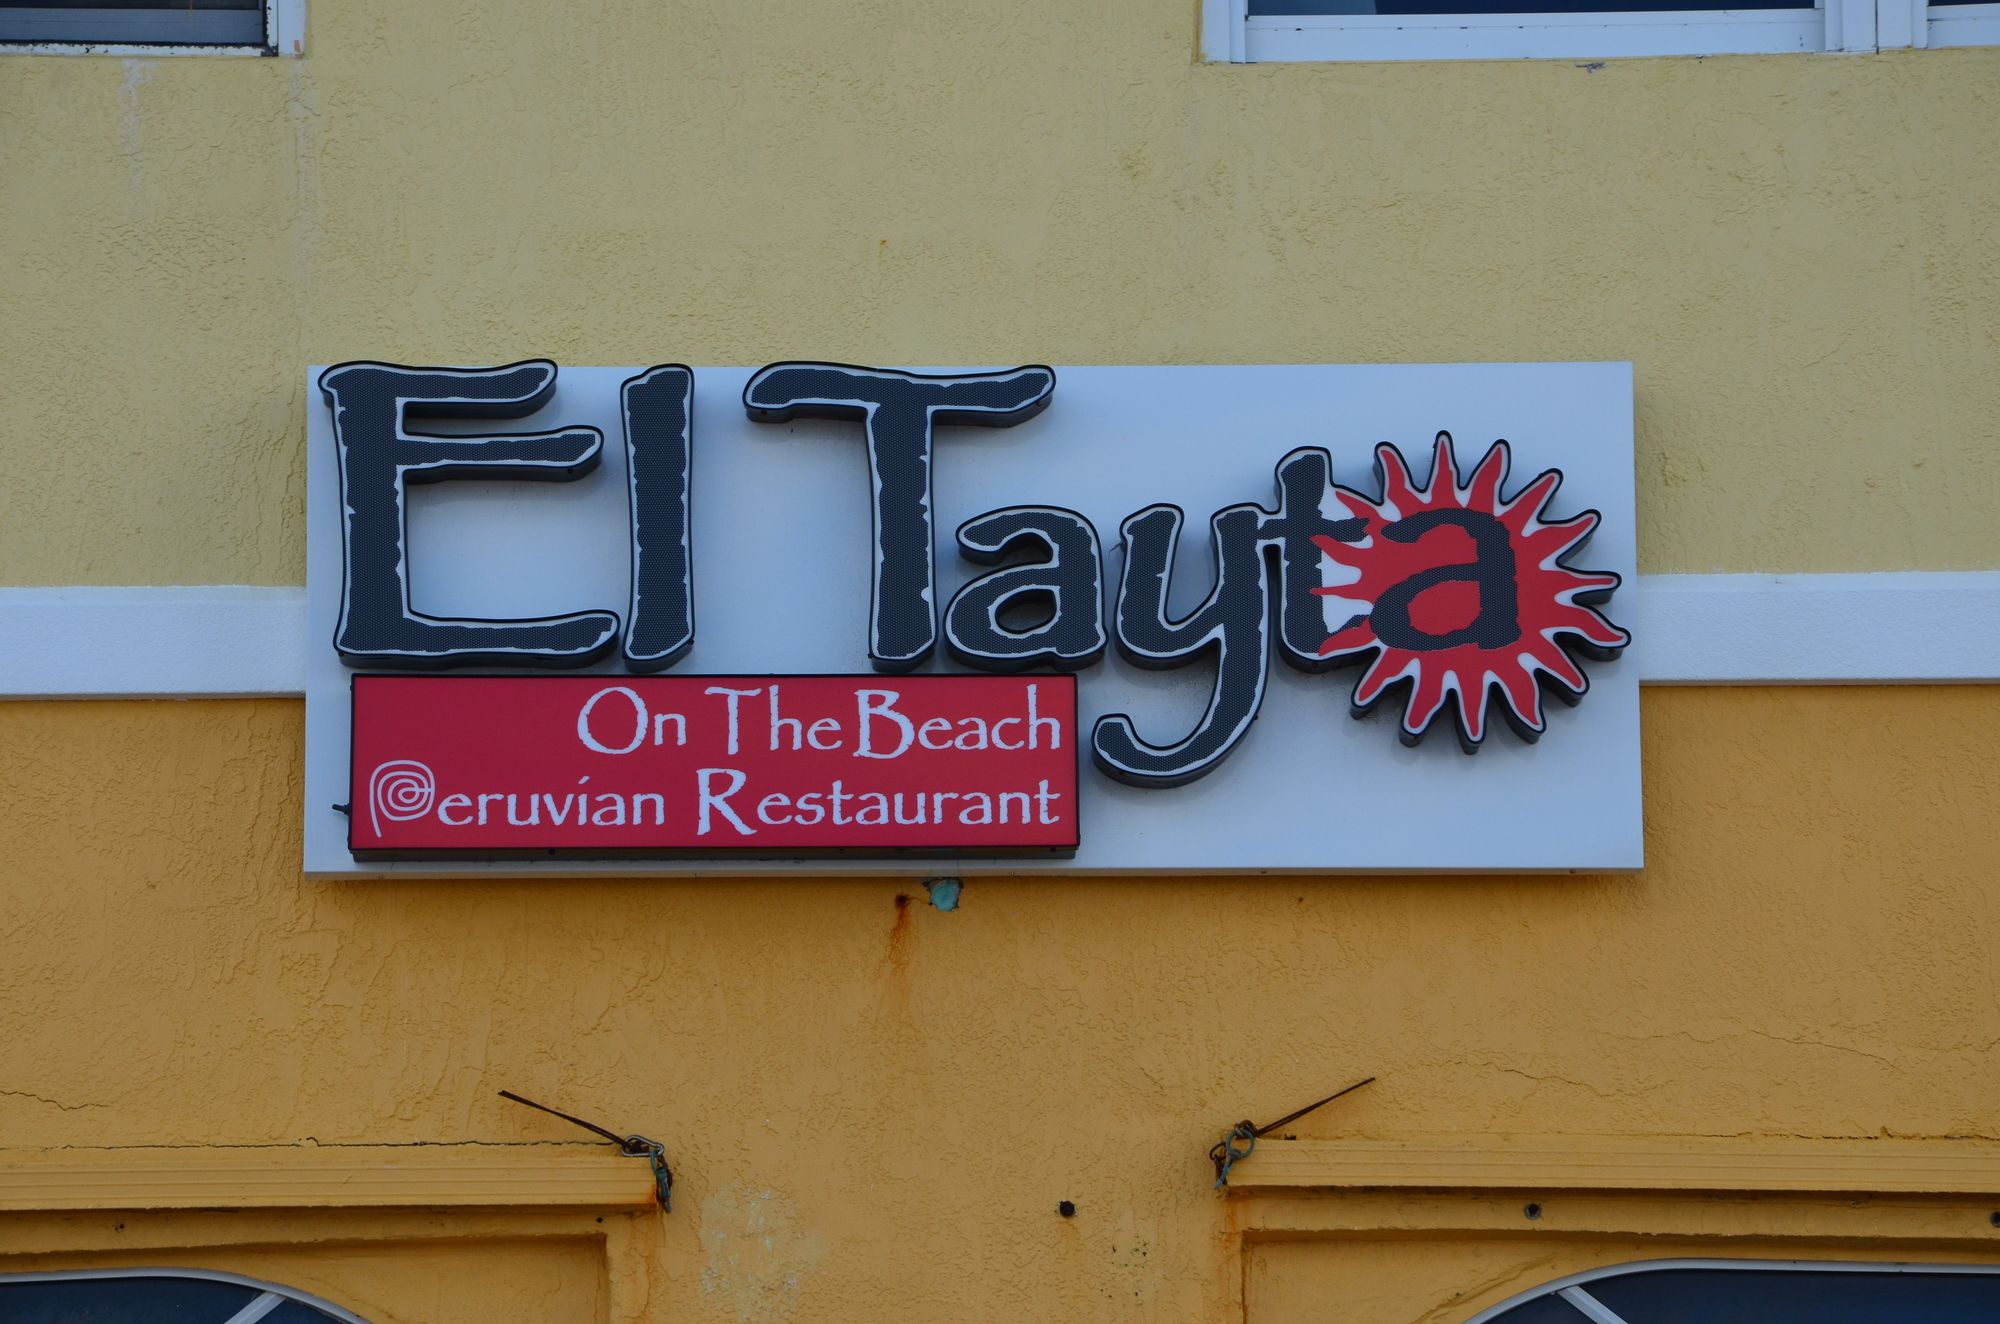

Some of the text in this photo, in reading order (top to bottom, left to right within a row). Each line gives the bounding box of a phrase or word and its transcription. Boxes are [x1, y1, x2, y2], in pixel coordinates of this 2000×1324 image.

[318, 360, 1525, 786] El Tayta
[577, 683, 1061, 759] On The Beach
[696, 767, 1061, 836] Restaurant
